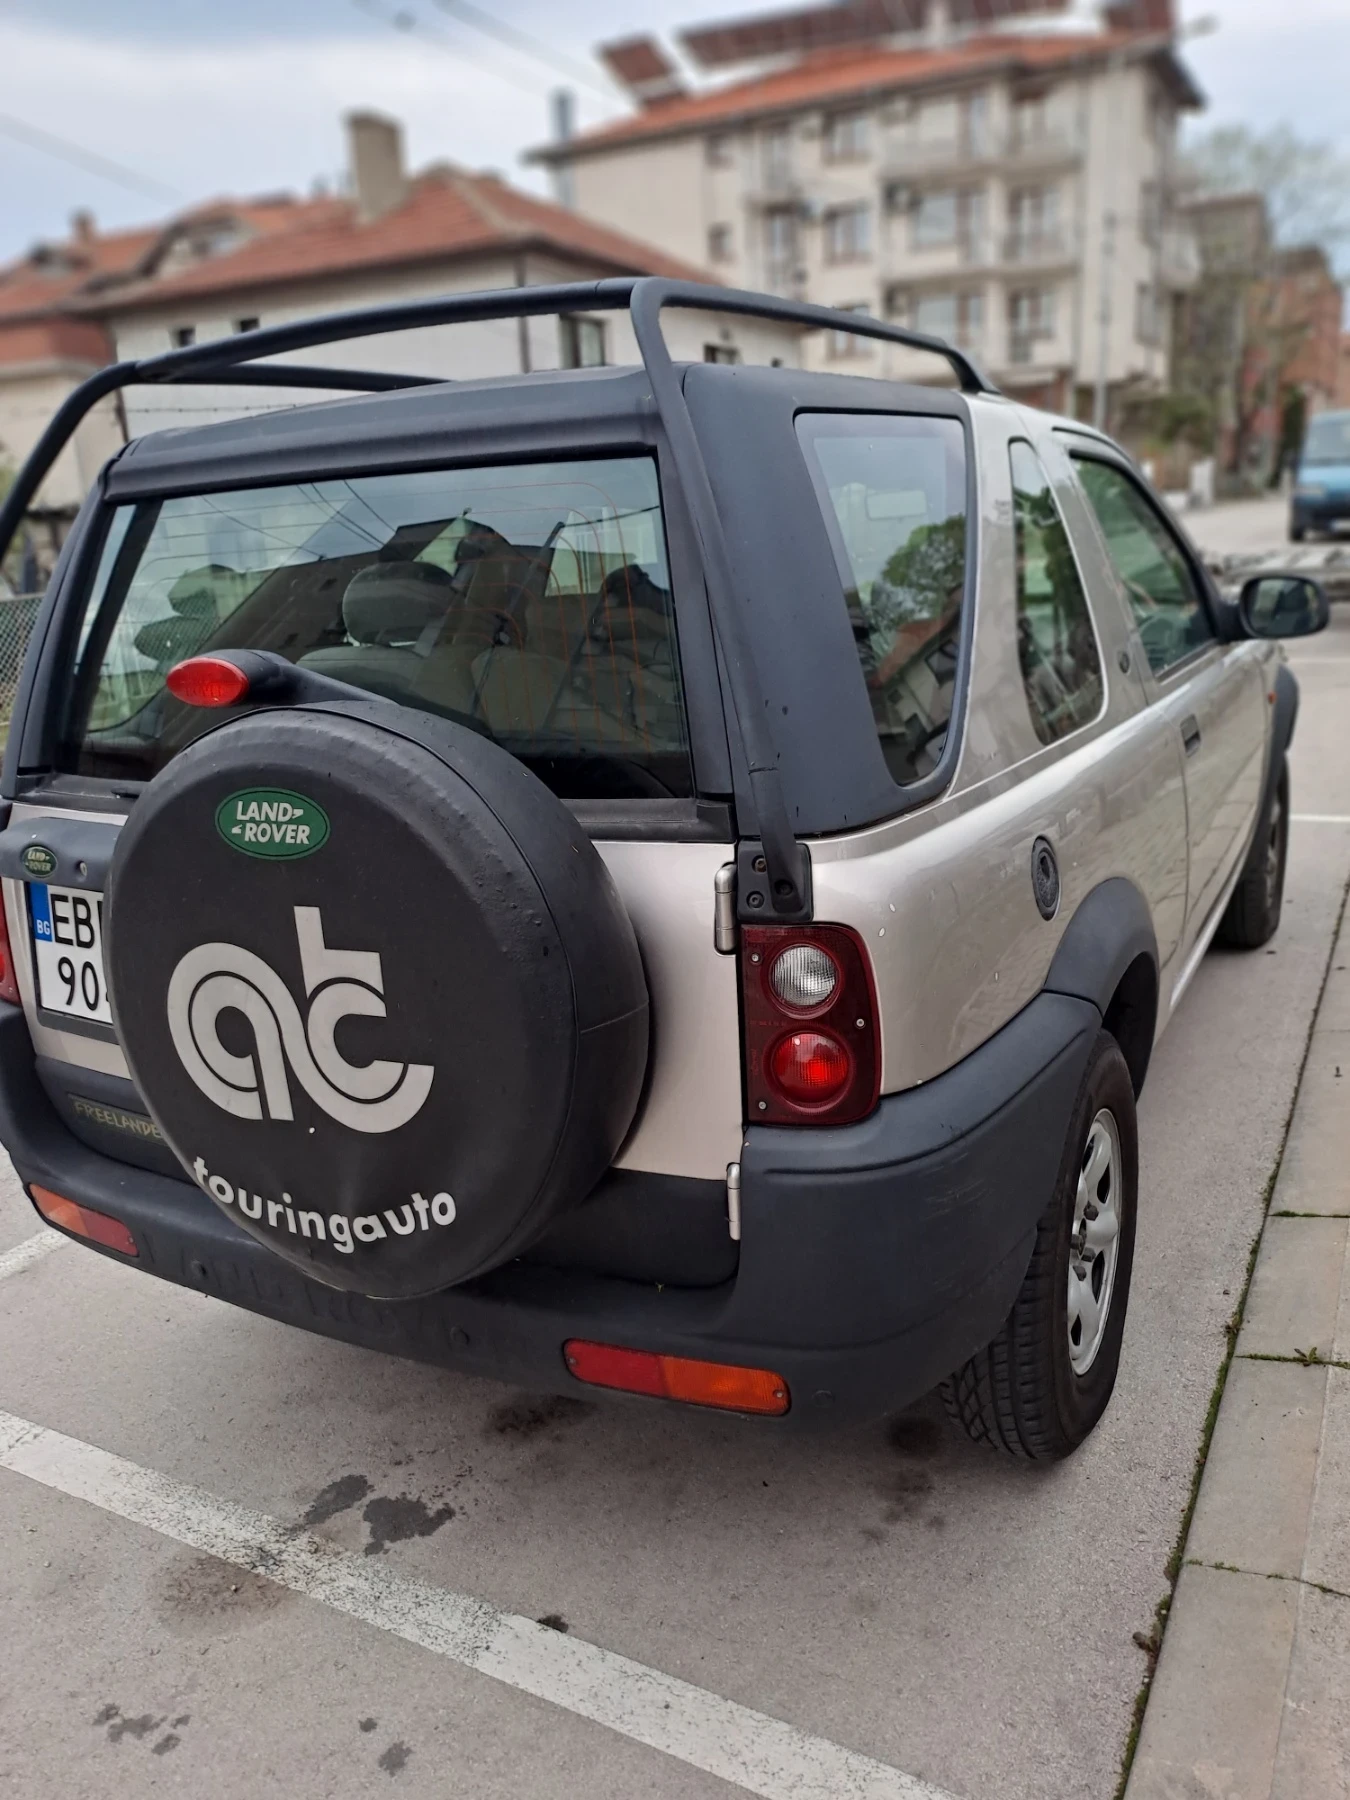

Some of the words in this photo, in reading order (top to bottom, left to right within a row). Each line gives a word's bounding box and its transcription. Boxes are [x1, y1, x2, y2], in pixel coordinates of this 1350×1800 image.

[244, 822, 311, 845] ROVER
[36, 919, 51, 935] BG
[50, 893, 103, 949] EB
[58, 956, 109, 1011] 90
[73, 1101, 163, 1139] FREELANDE
[194, 1156, 457, 1254] touringauto
